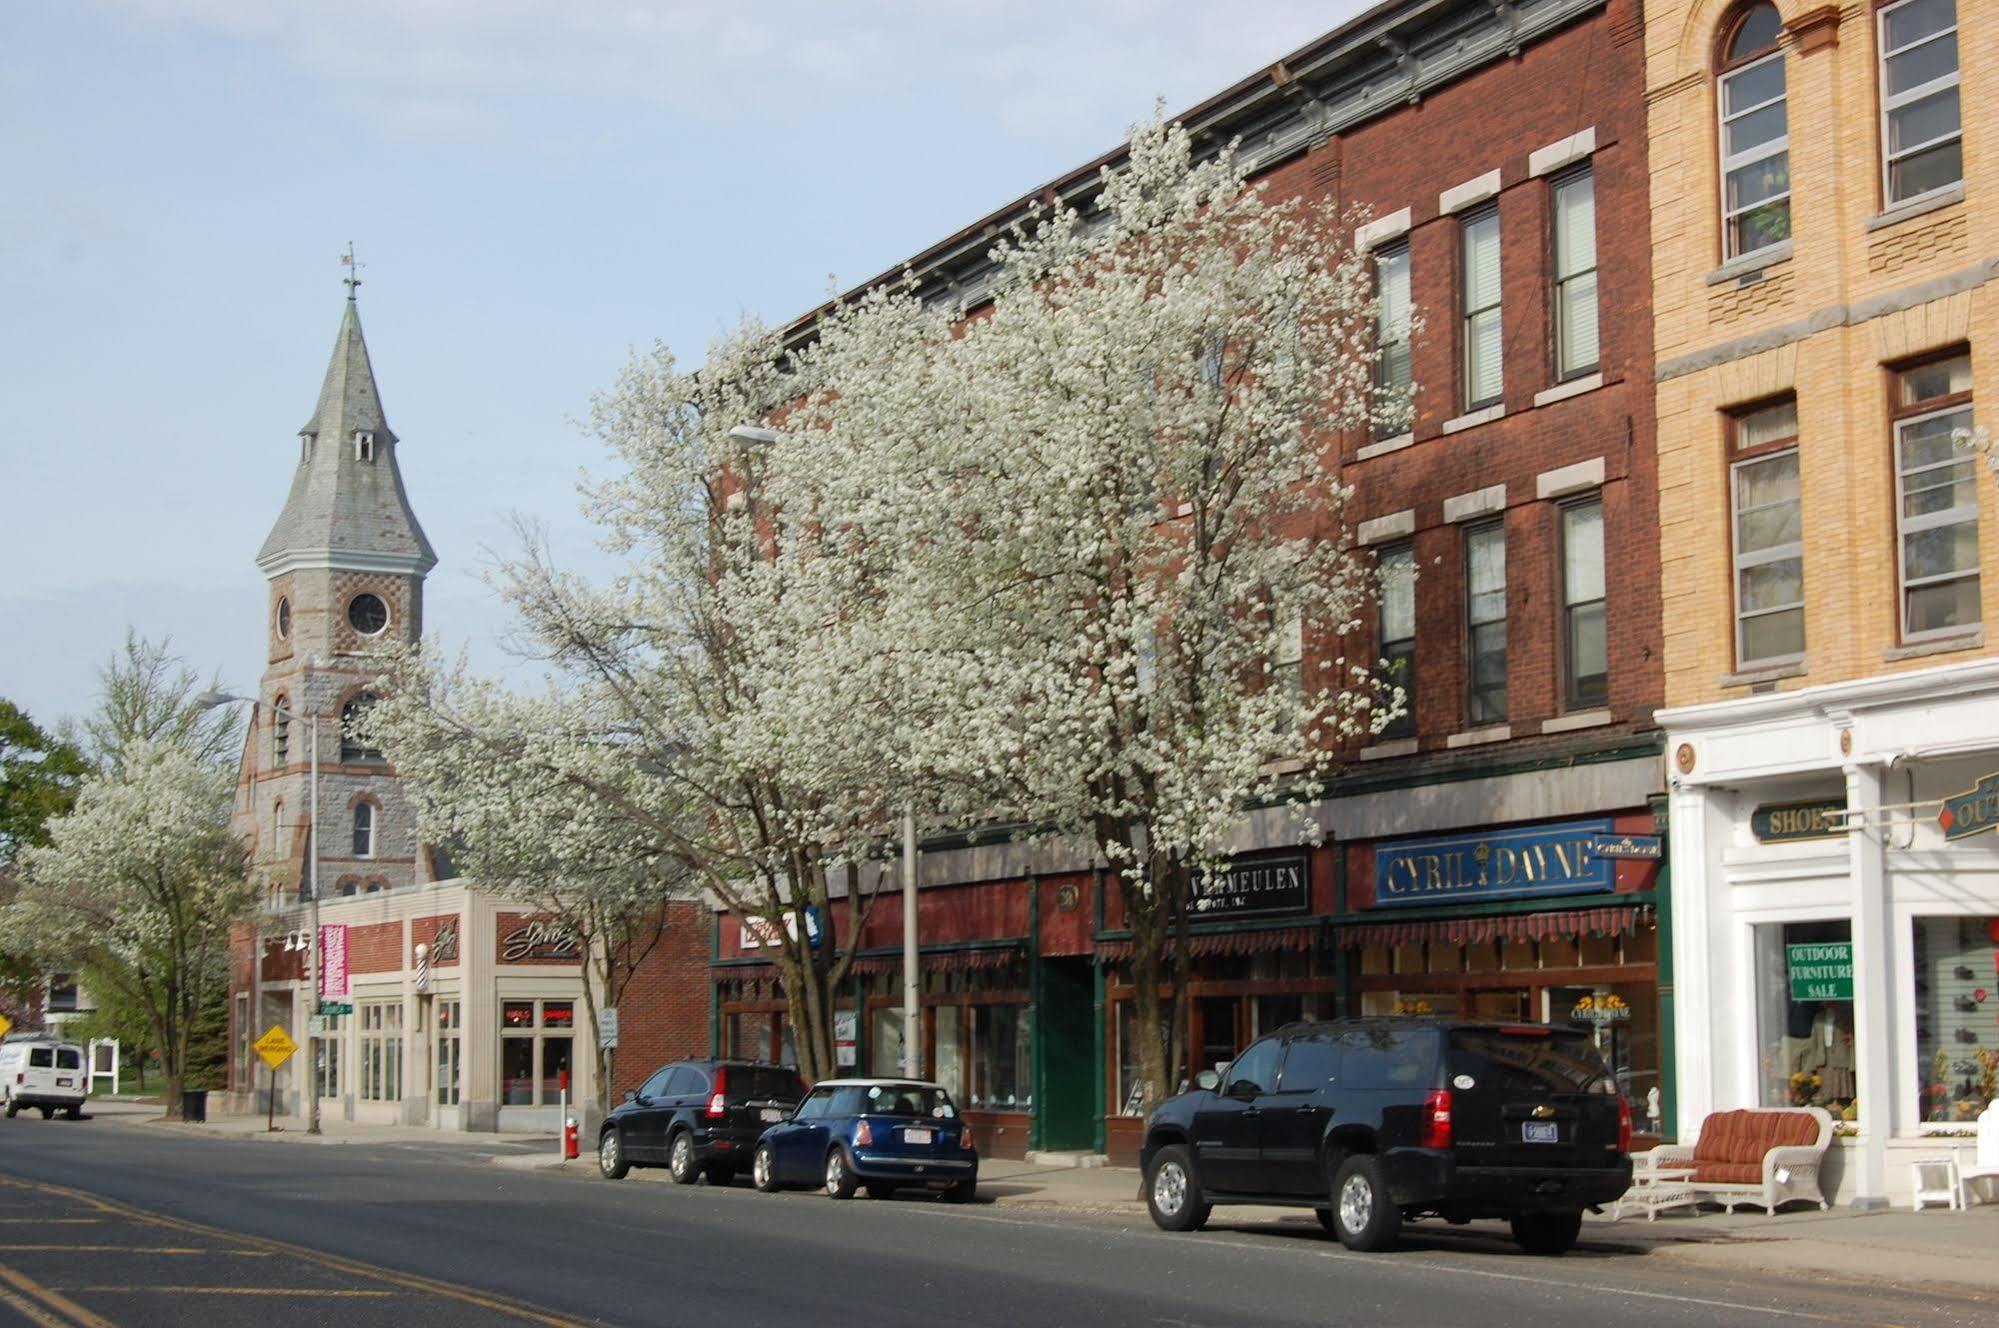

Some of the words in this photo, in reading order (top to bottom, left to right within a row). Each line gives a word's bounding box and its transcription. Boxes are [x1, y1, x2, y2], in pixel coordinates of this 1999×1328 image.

[1387, 849, 1472, 894] CYRIL
[1495, 839, 1594, 885] DAYNE
[1791, 946, 1849, 961] OUTDOOR
[1791, 964, 1853, 980] FURNITURE
[1807, 983, 1838, 998] SALE
